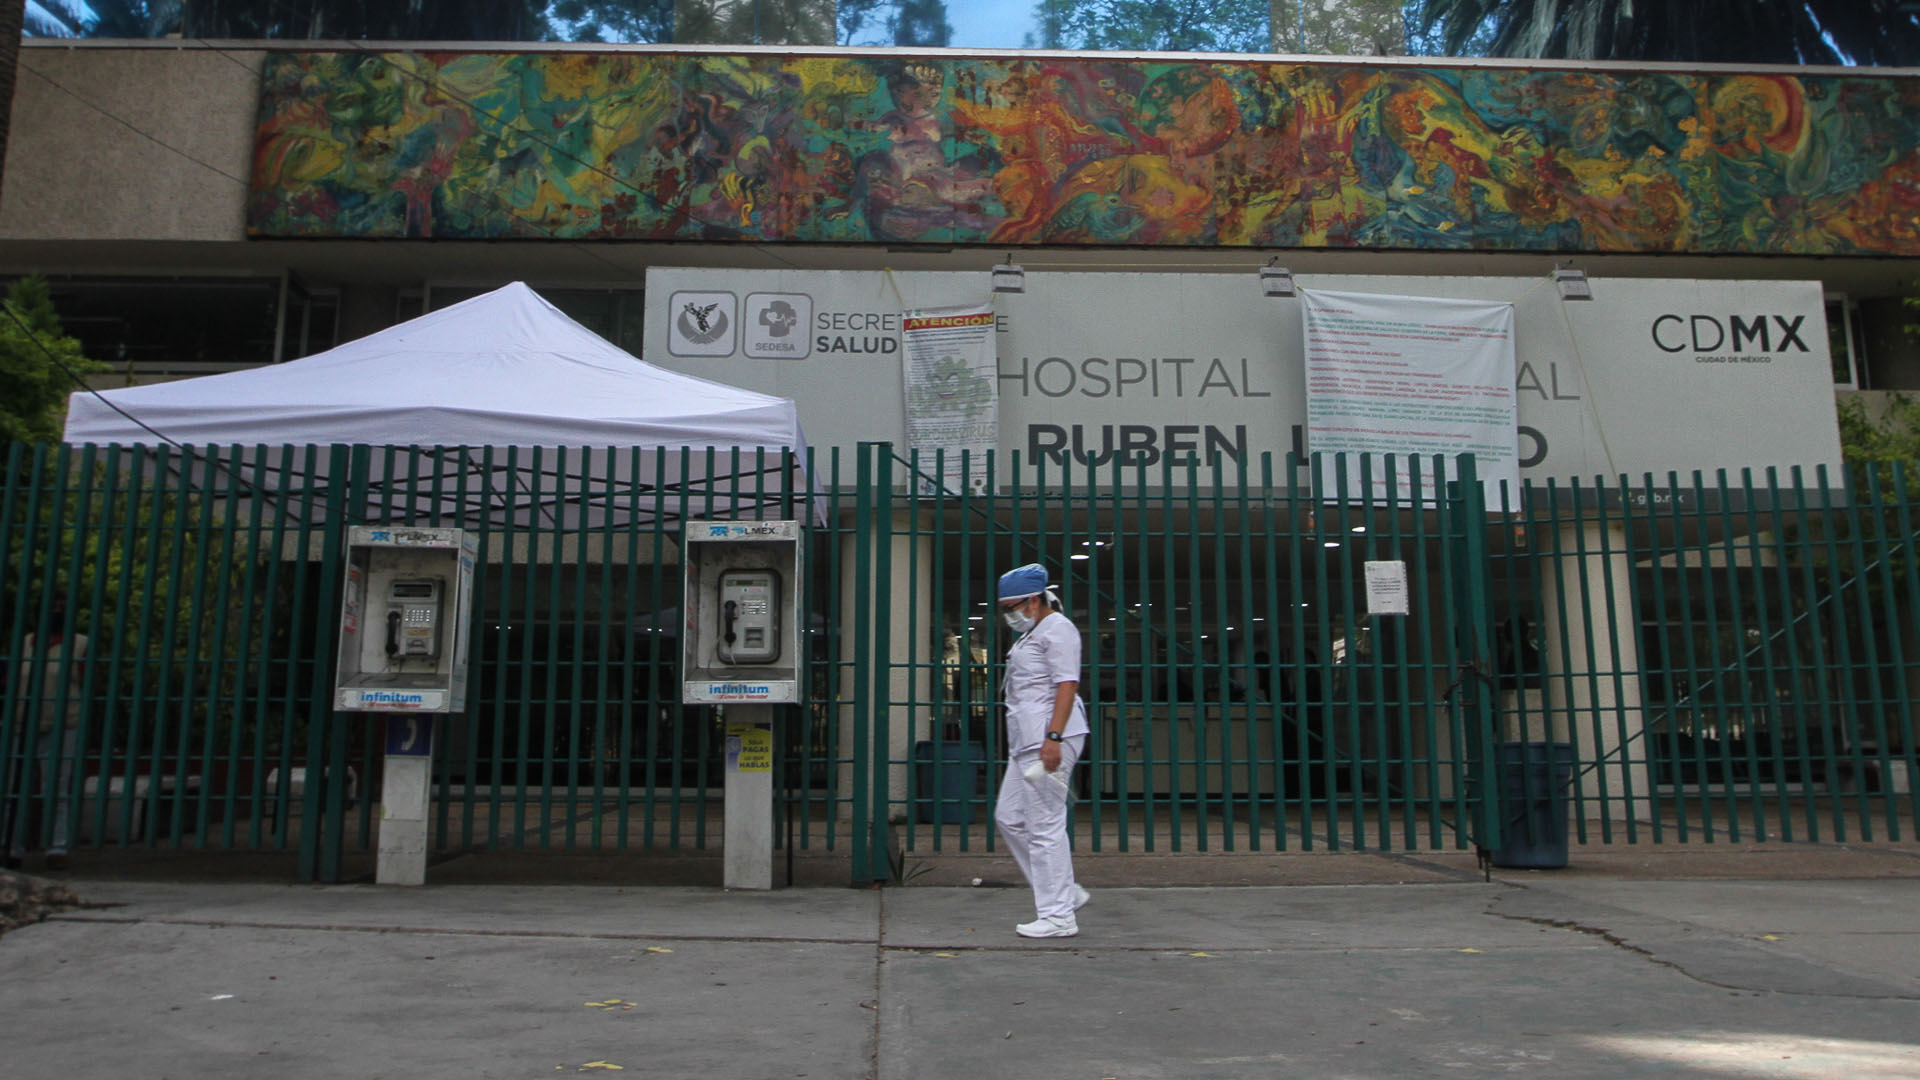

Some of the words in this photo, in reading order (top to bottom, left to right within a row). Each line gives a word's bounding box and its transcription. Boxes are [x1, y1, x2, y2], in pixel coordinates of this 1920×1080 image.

[909, 315, 993, 329] ATENCIÓN
[996, 315, 1009, 333] E
[1652, 314, 1810, 353] CDMX
[755, 342, 796, 352] SEDESA
[816, 336, 897, 354] SALUD
[997, 357, 1271, 398] HOSPITAL
[1028, 424, 1248, 467] RUBEN
[733, 527, 776, 535] LMEX
[361, 692, 422, 702] infinitum
[709, 684, 768, 694] infinitum
